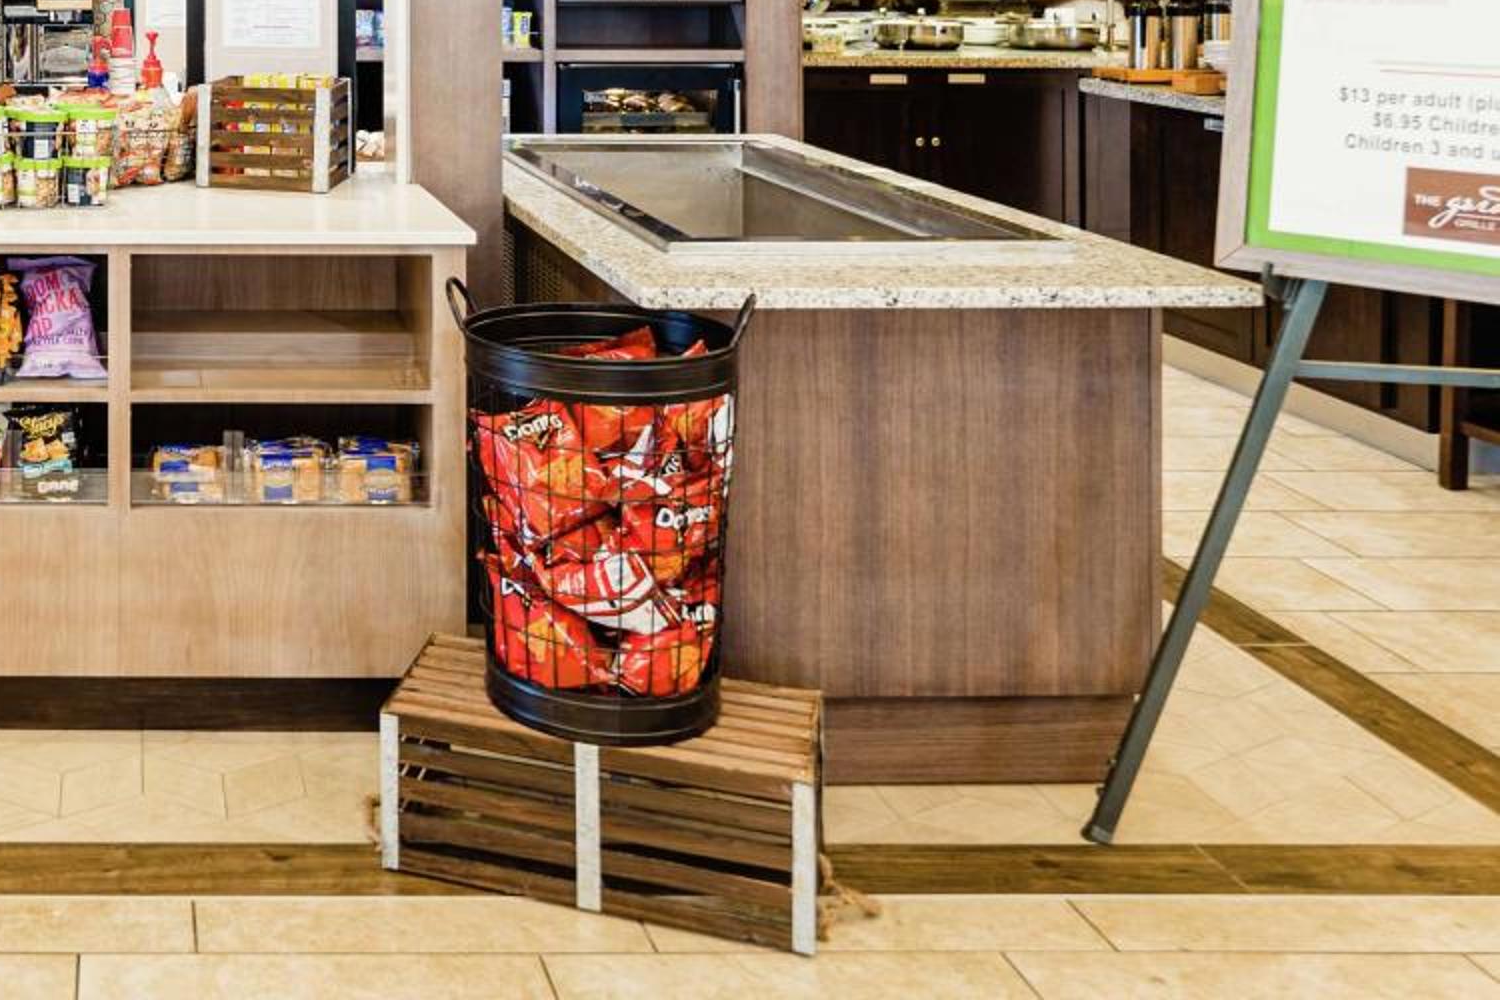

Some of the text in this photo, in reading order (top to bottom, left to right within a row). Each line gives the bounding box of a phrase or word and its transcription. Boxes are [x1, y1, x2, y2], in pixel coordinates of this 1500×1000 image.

[1339, 87, 1370, 103] $13
[1377, 92, 1407, 107] per
[1413, 92, 1461, 109] adult
[1346, 133, 1424, 154] Children
[1447, 143, 1485, 160] and
